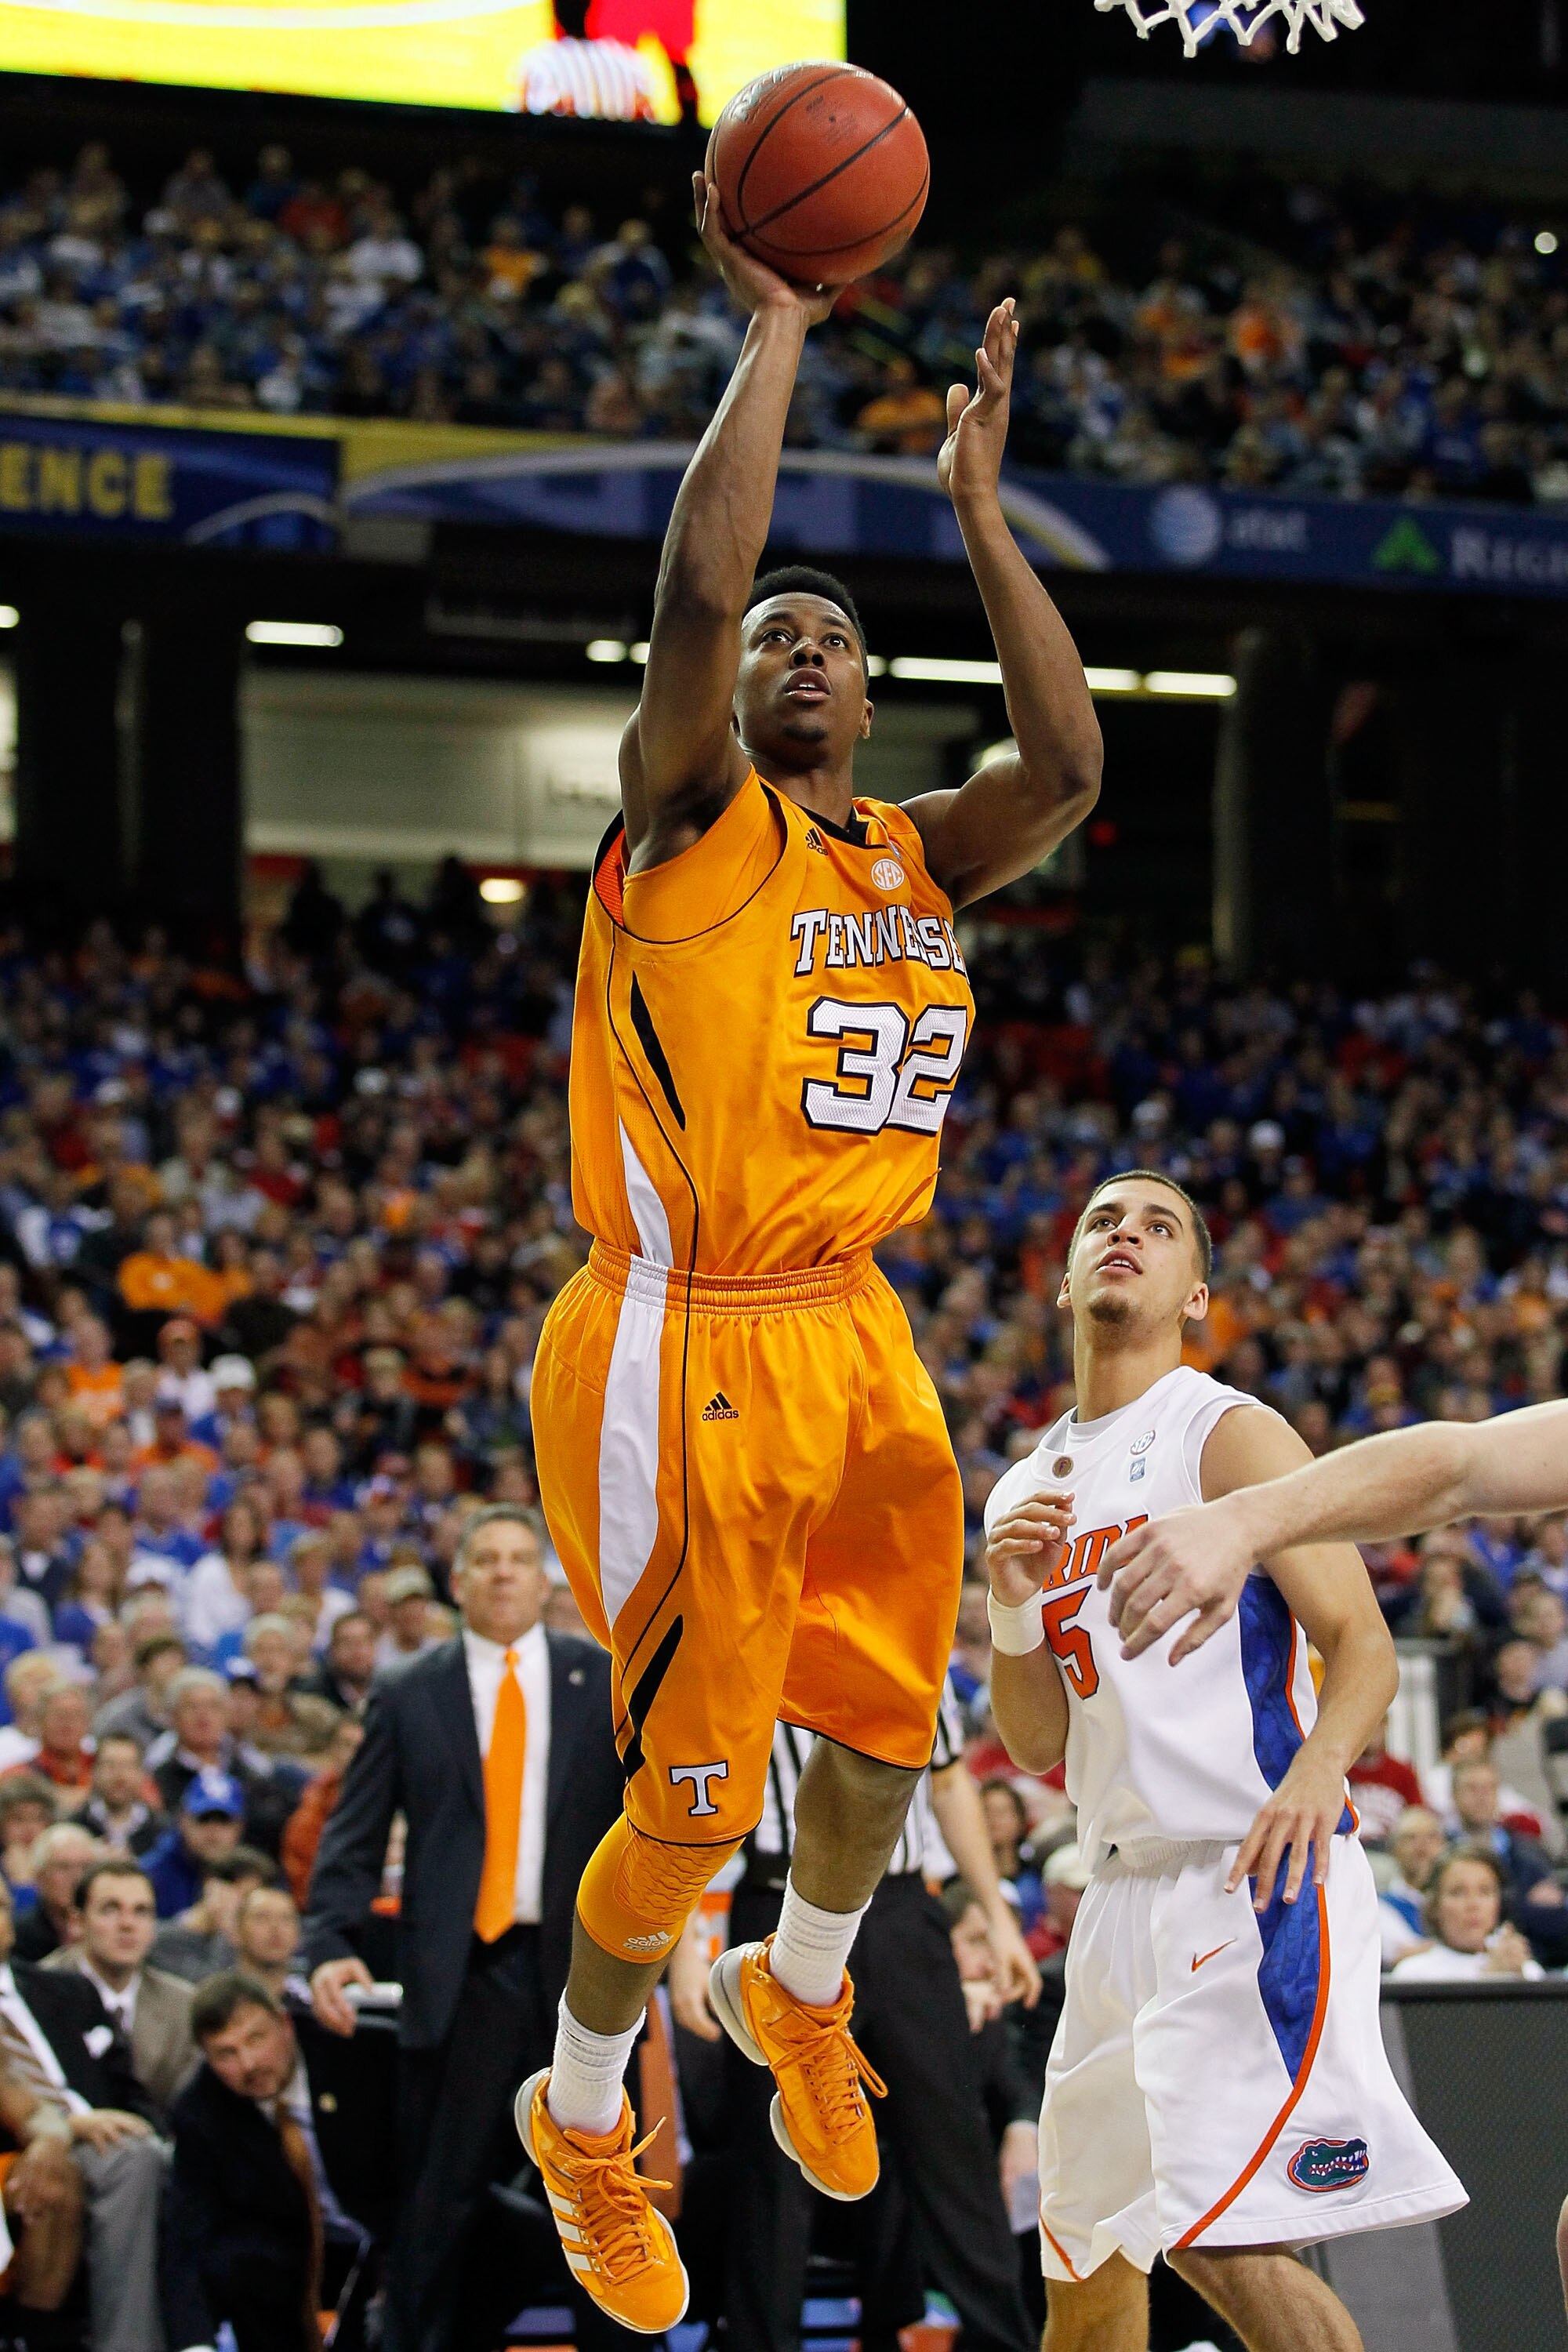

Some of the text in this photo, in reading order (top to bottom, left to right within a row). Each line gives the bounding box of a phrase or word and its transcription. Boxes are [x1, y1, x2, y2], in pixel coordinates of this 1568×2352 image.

[873, 860, 902, 889] SEC
[800, 995, 967, 1137] 32
[702, 1409, 739, 1421] adidas
[1041, 1584, 1099, 1700] 5
[669, 1760, 728, 1817] T
